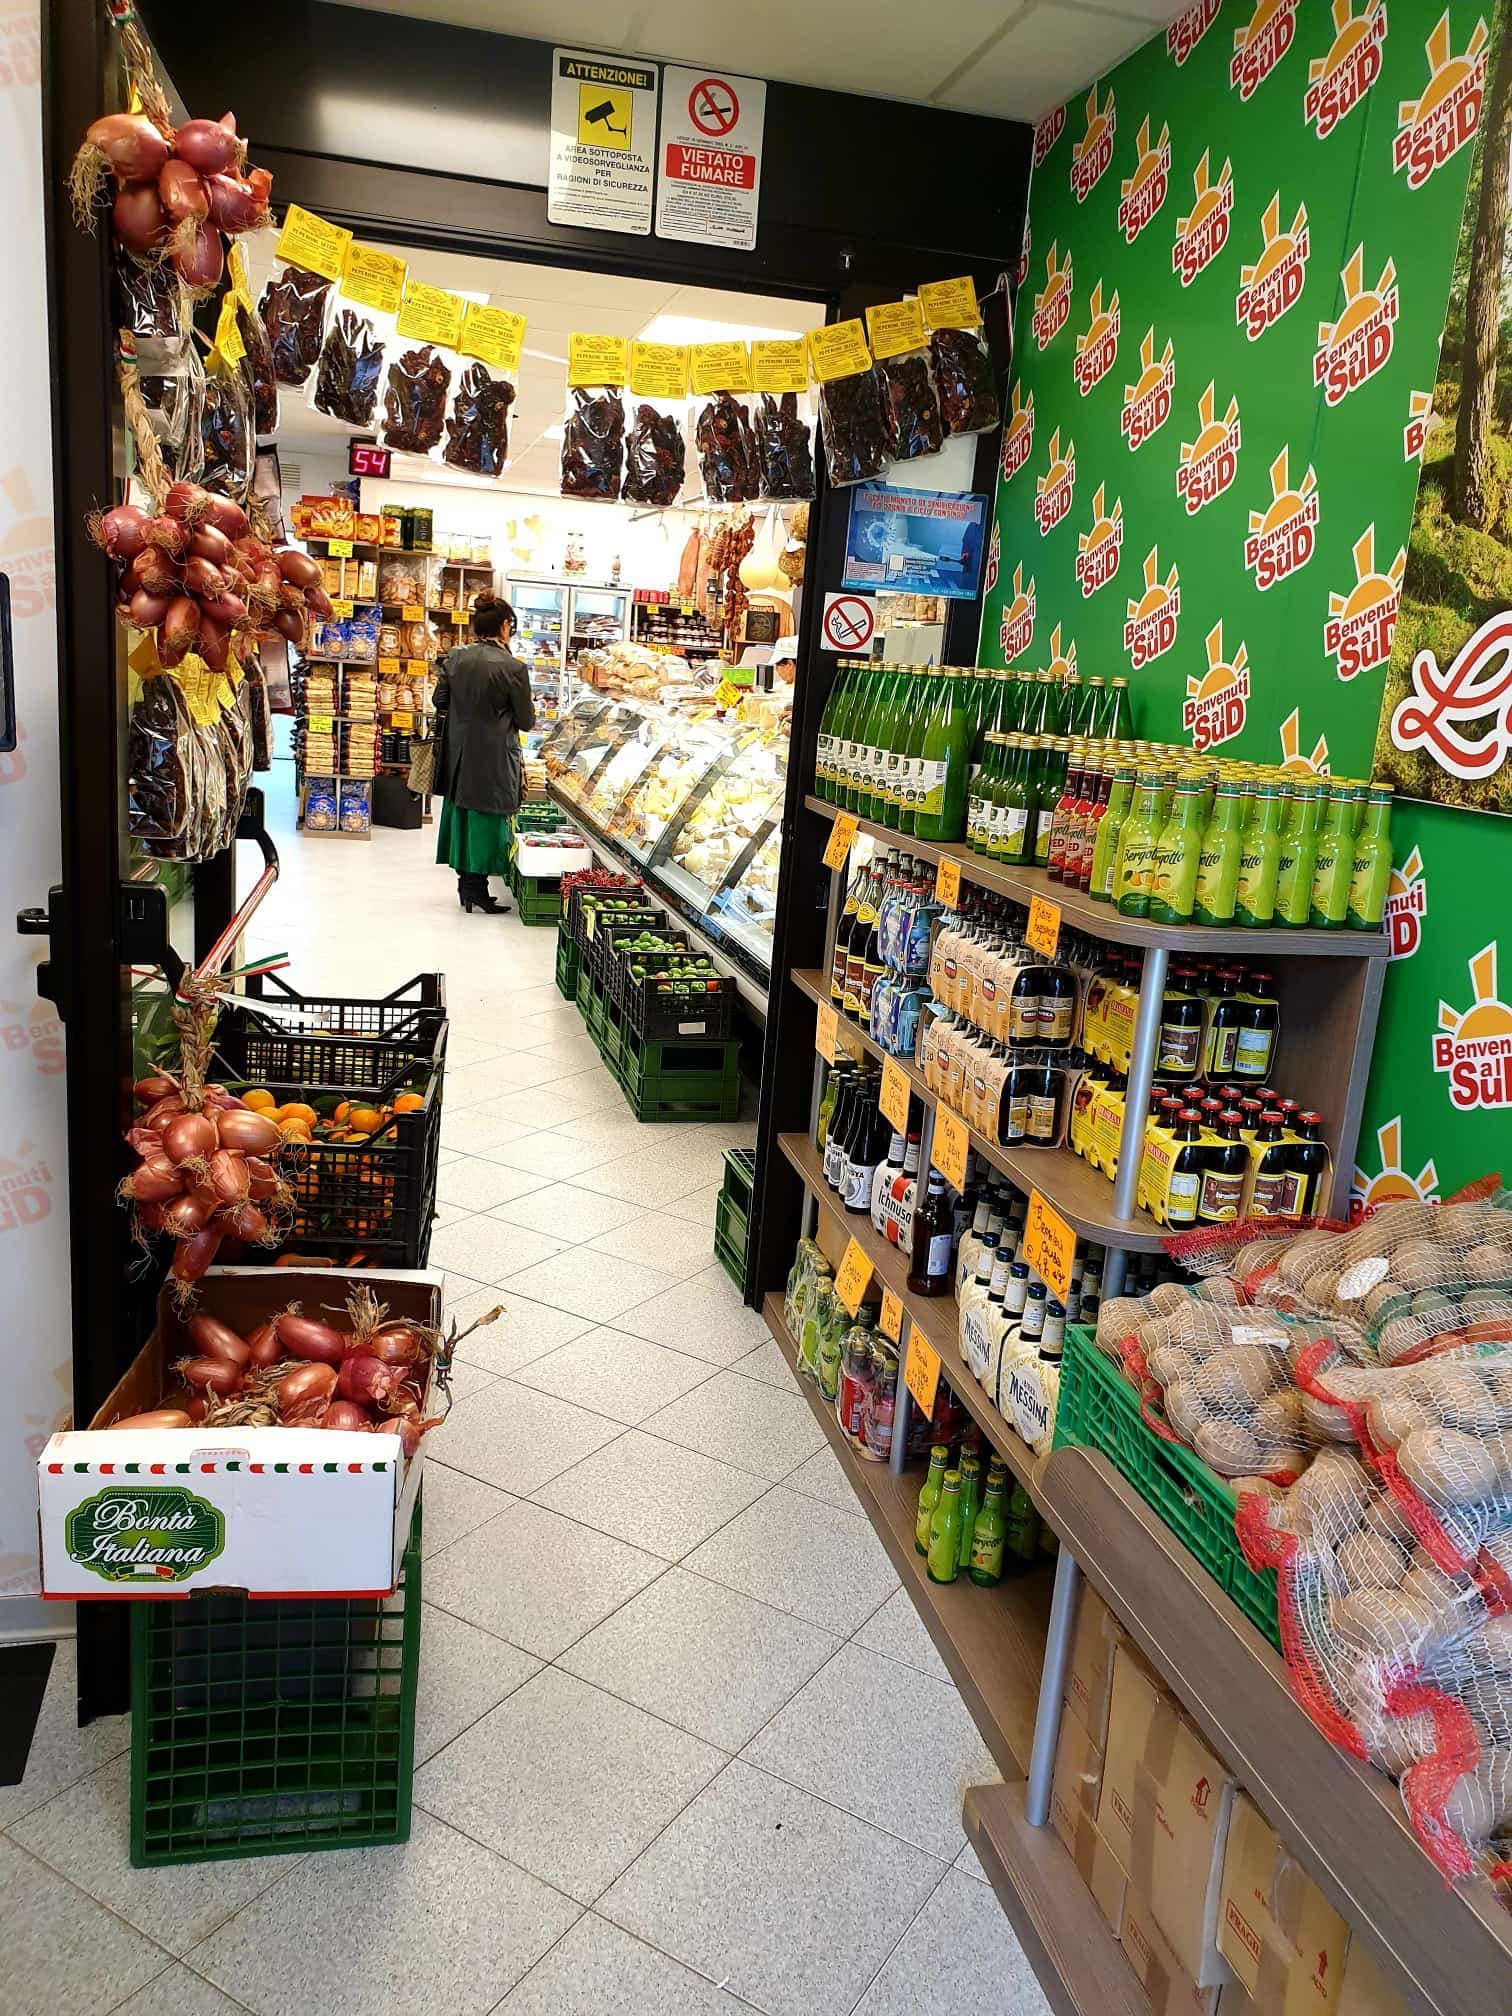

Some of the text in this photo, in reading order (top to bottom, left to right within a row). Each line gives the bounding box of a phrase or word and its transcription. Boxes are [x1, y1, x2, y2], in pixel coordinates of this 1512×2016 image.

[567, 62, 647, 87] ATTENZIONE!
[1305, 9, 1386, 119] Benvenuti
[564, 154, 650, 174] VIDEOSORVEGLIANZA
[565, 145, 643, 162] AREA SOTTOPOSTA
[595, 168, 612, 177] PER
[681, 147, 743, 170] VIETATO
[681, 163, 744, 185] FUMARE
[557, 173, 591, 185] RAGIONI
[593, 178, 602, 186] DI
[603, 180, 648, 192] SICUREZZA
[1118, 147, 1170, 229] Benvenuti
[1173, 181, 1232, 270] Benvenuti
[1237, 234, 1308, 320] Benvenuti
[1033, 272, 1072, 335] Benvenuti
[1074, 314, 1119, 377] Benvenuti
[1315, 292, 1396, 381] Benvenuti
[1122, 367, 1173, 431] Benvenuti
[354, 450, 387, 474] 54
[1178, 430, 1238, 491] Benvenuti
[1035, 466, 1074, 516] Benvenuti
[1076, 525, 1122, 576] Benvenuti
[1246, 501, 1317, 565] Benvenuti
[1001, 603, 1035, 642] Benvenuti
[1126, 595, 1179, 645] Benvenuti
[1326, 592, 1400, 651] Benvenut
[1184, 678, 1247, 728] Benvenuti
[1436, 1038, 1511, 1067] Benven
[1009, 1371, 1049, 1432] MESSINA
[93, 1498, 198, 1531] Bontà
[70, 1530, 206, 1563] Italiana
